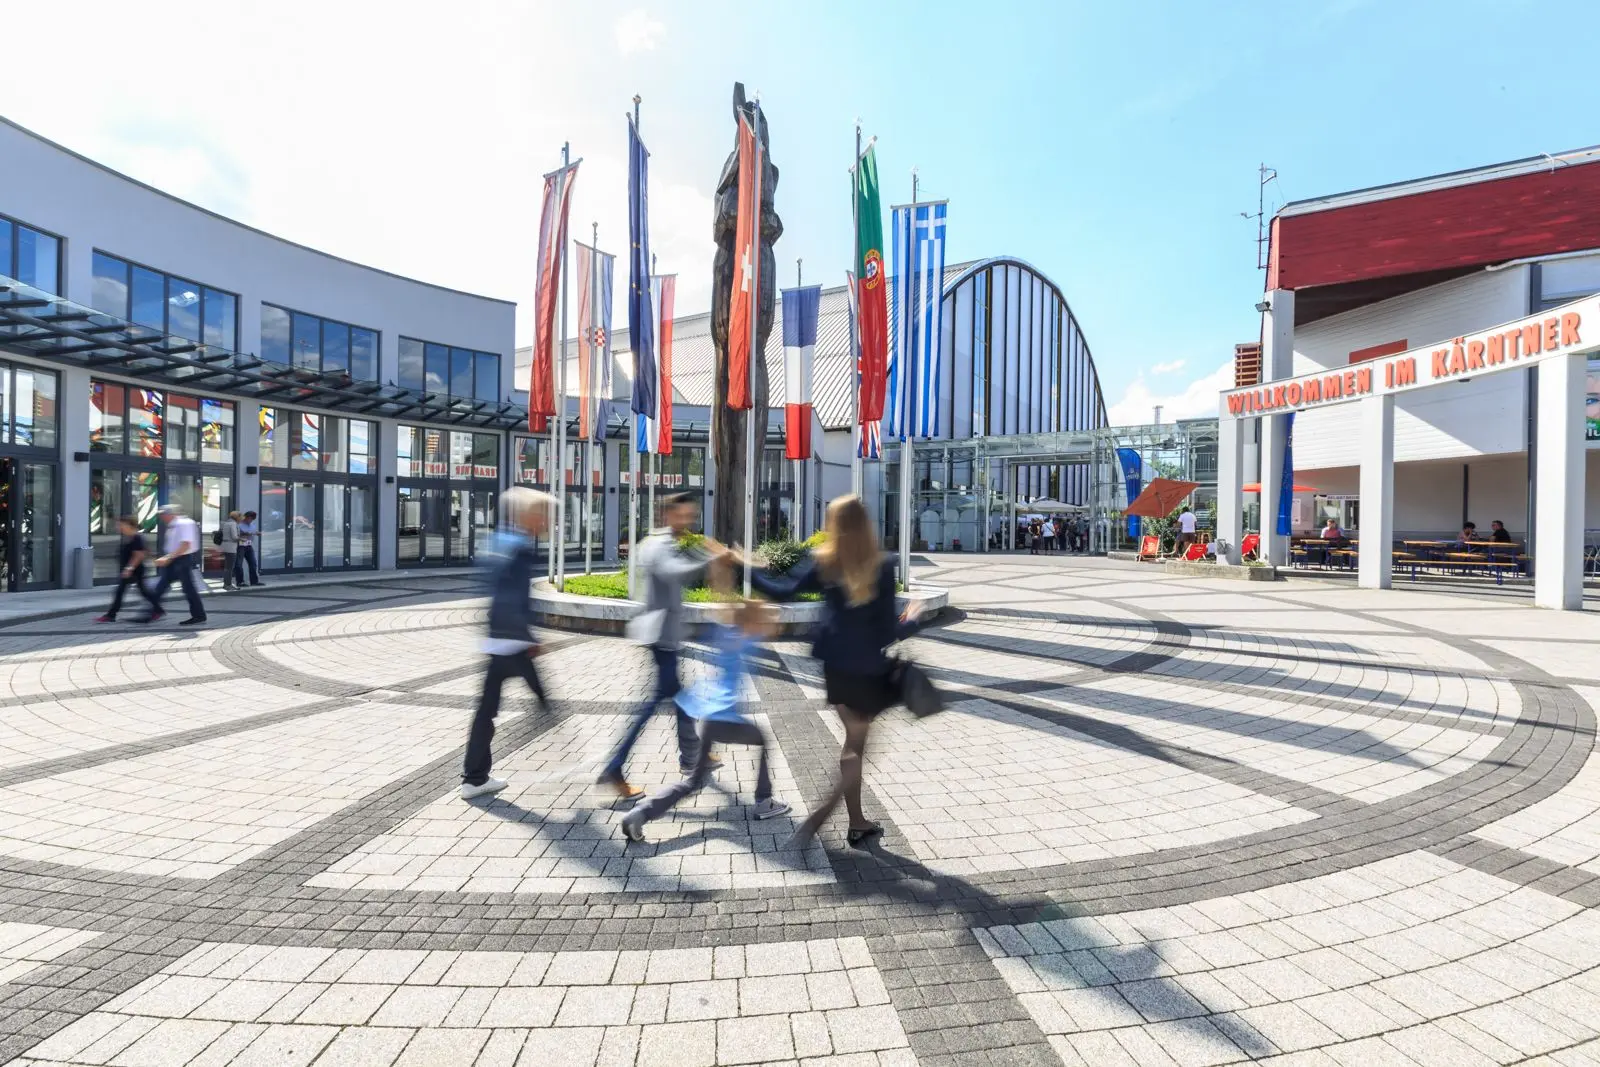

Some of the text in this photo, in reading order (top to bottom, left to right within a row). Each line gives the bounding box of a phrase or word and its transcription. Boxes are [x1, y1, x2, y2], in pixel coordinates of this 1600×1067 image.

[1227, 312, 1581, 415] WILLKOMMEN IM KÄRNTNER
